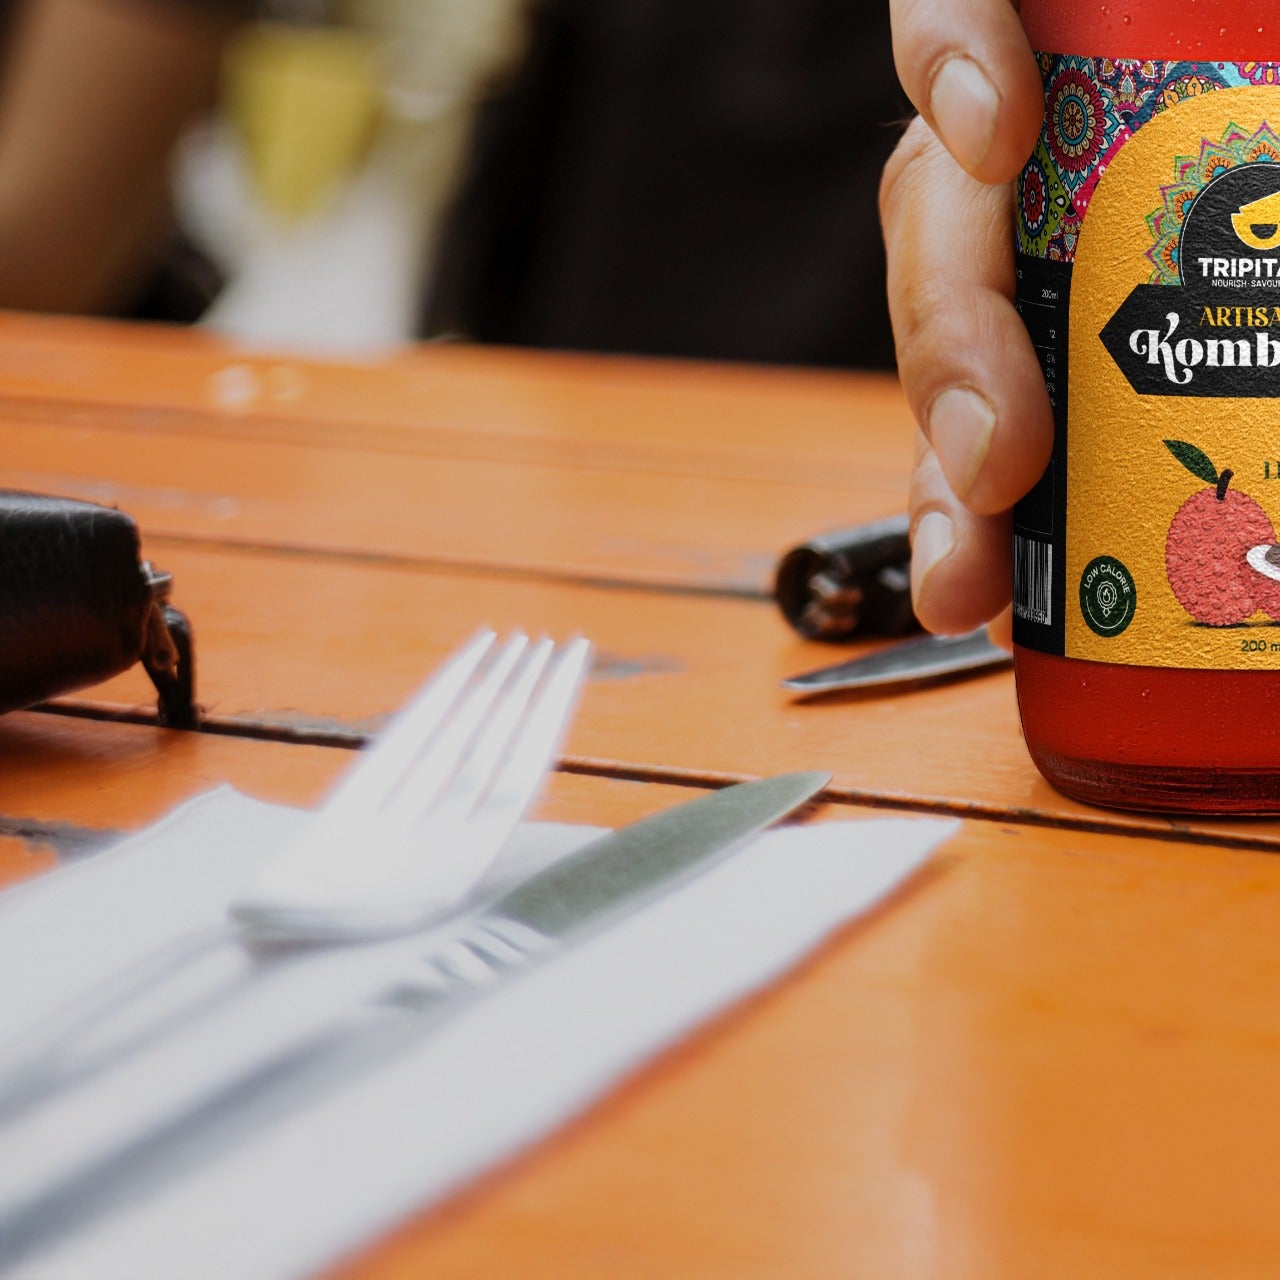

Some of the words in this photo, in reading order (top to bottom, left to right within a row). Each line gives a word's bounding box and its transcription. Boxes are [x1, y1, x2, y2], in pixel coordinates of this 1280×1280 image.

[1211, 279, 1247, 288] NOURISH
[1084, 566, 1099, 589] LOW
[1100, 564, 1131, 594] CALORIE
[1241, 639, 1267, 652] 200
